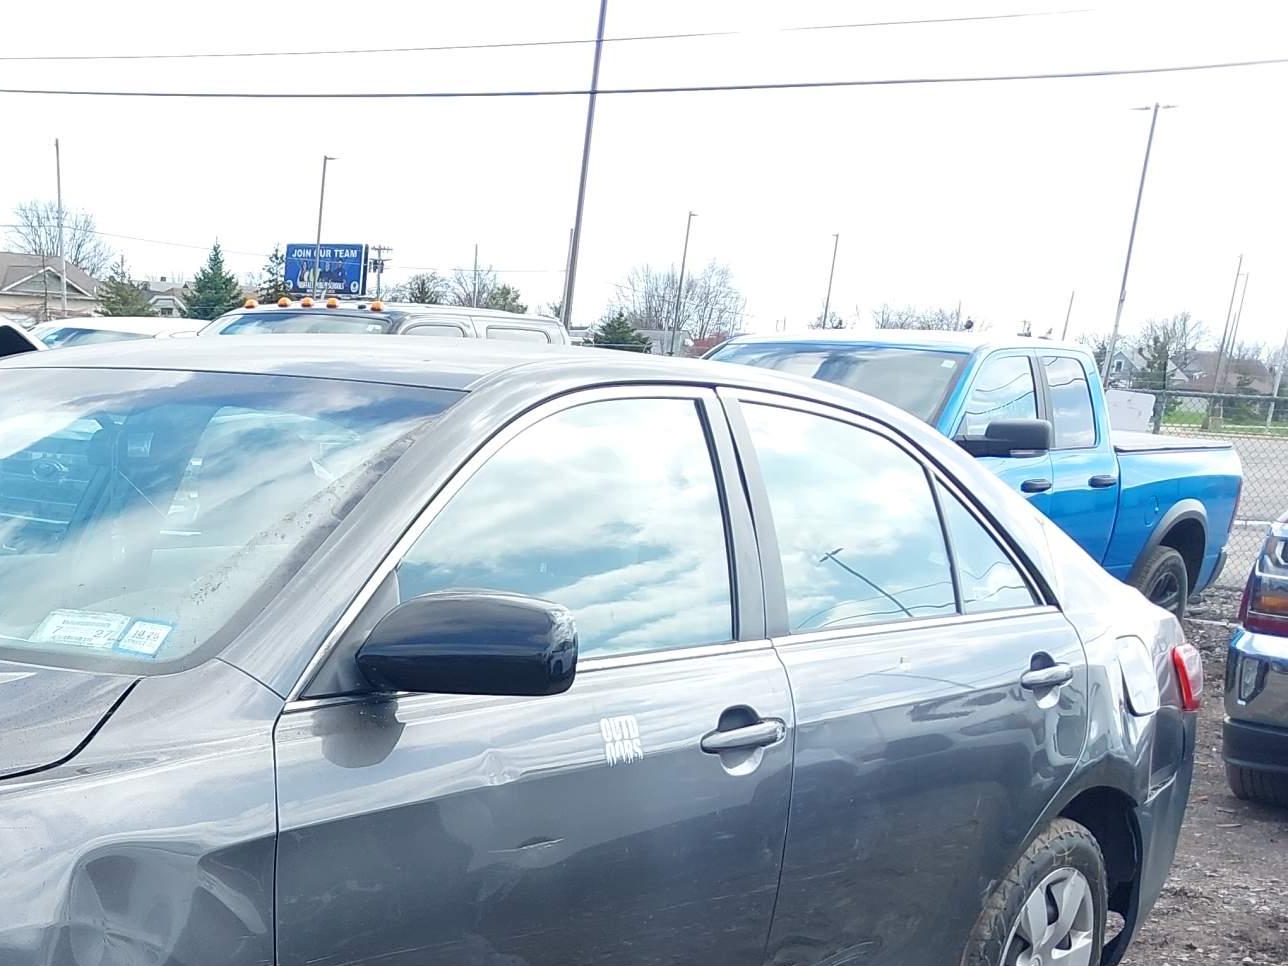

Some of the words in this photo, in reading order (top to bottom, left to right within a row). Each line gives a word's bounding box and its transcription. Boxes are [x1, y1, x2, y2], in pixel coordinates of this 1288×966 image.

[292, 249, 312, 258] JOIN
[334, 249, 357, 258] TEAM
[600, 715, 640, 742] OUTD
